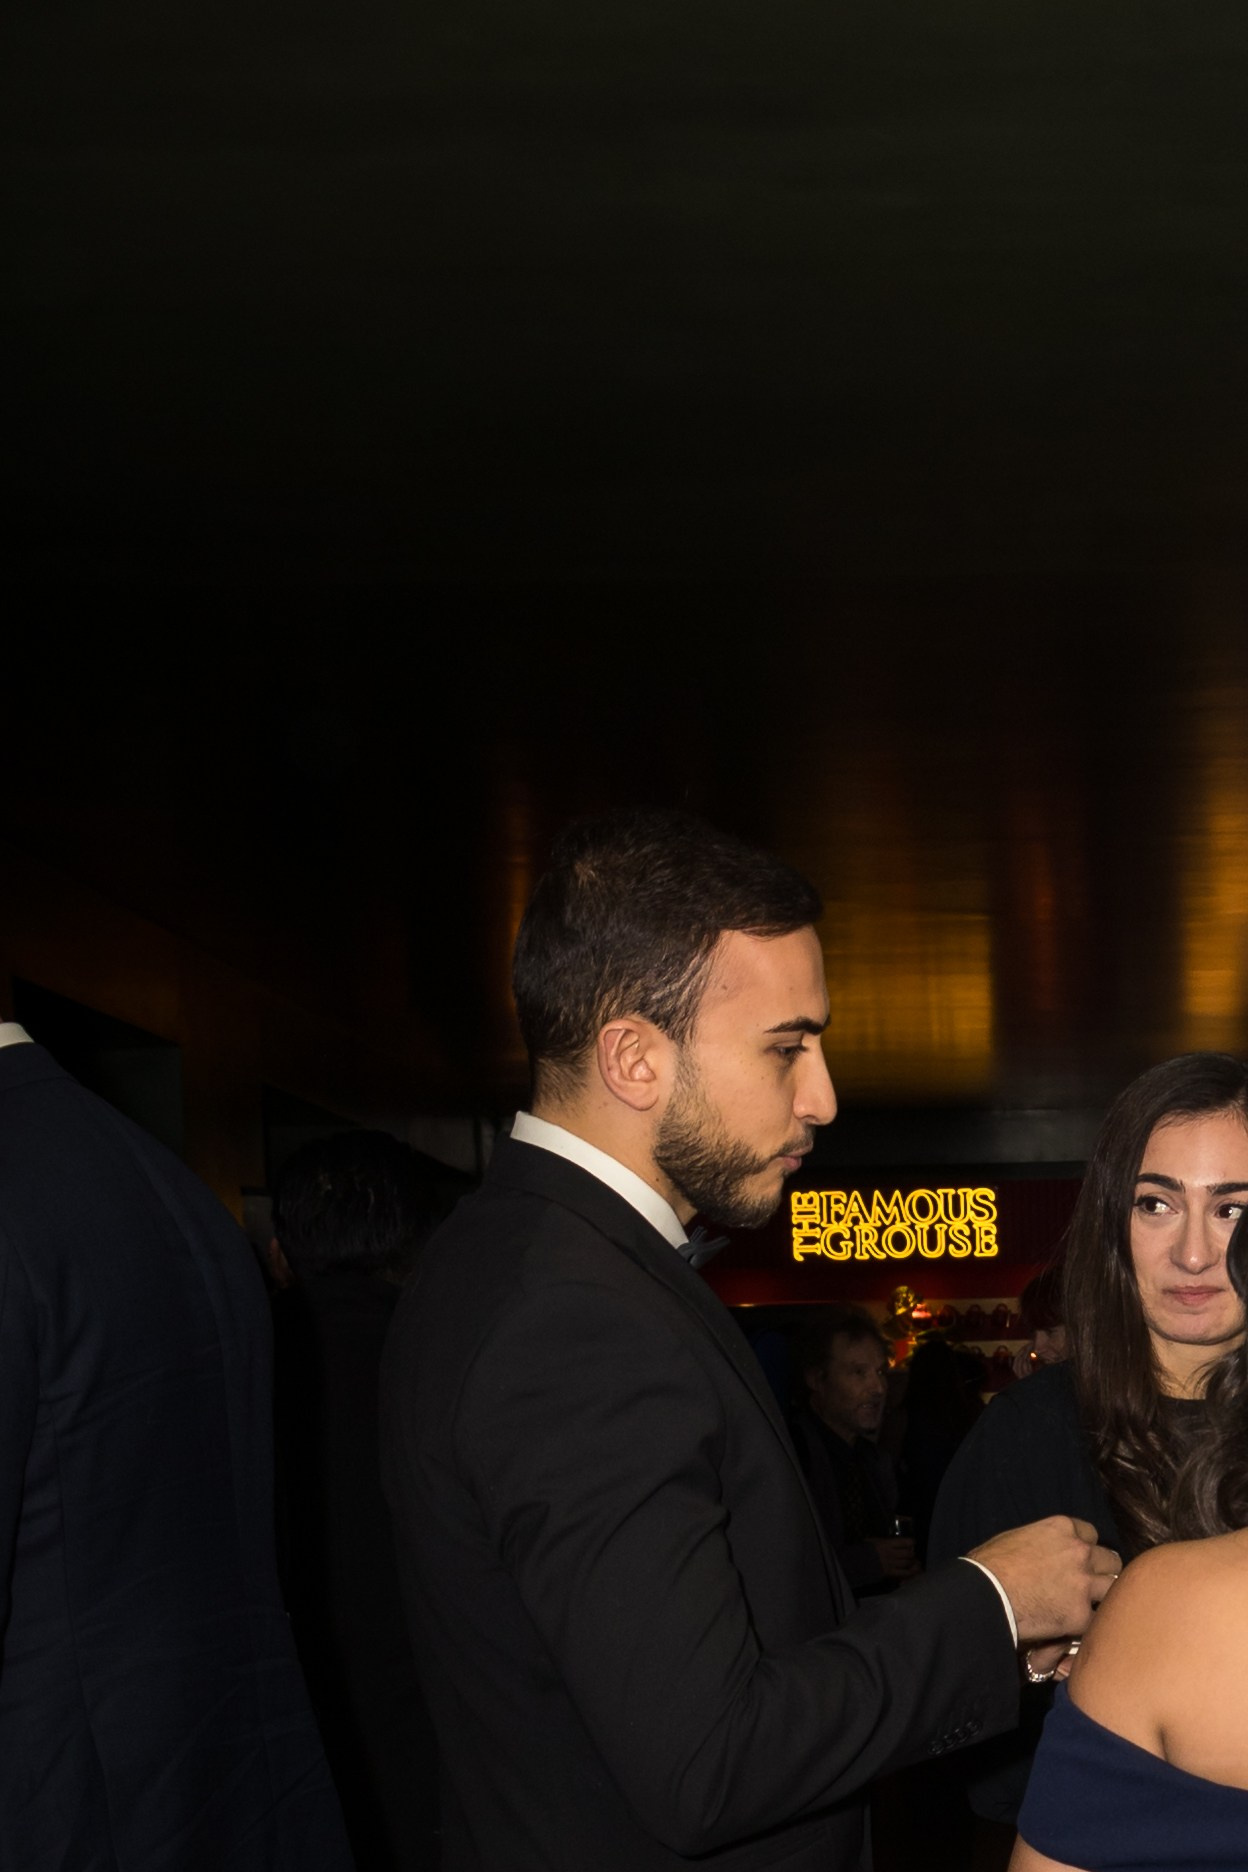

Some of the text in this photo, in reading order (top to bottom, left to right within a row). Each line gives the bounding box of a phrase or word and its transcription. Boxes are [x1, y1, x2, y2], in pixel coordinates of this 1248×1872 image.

[791, 1191, 821, 1261] THE
[820, 1188, 997, 1227] FAMOUS
[820, 1224, 998, 1261] GROUSE
